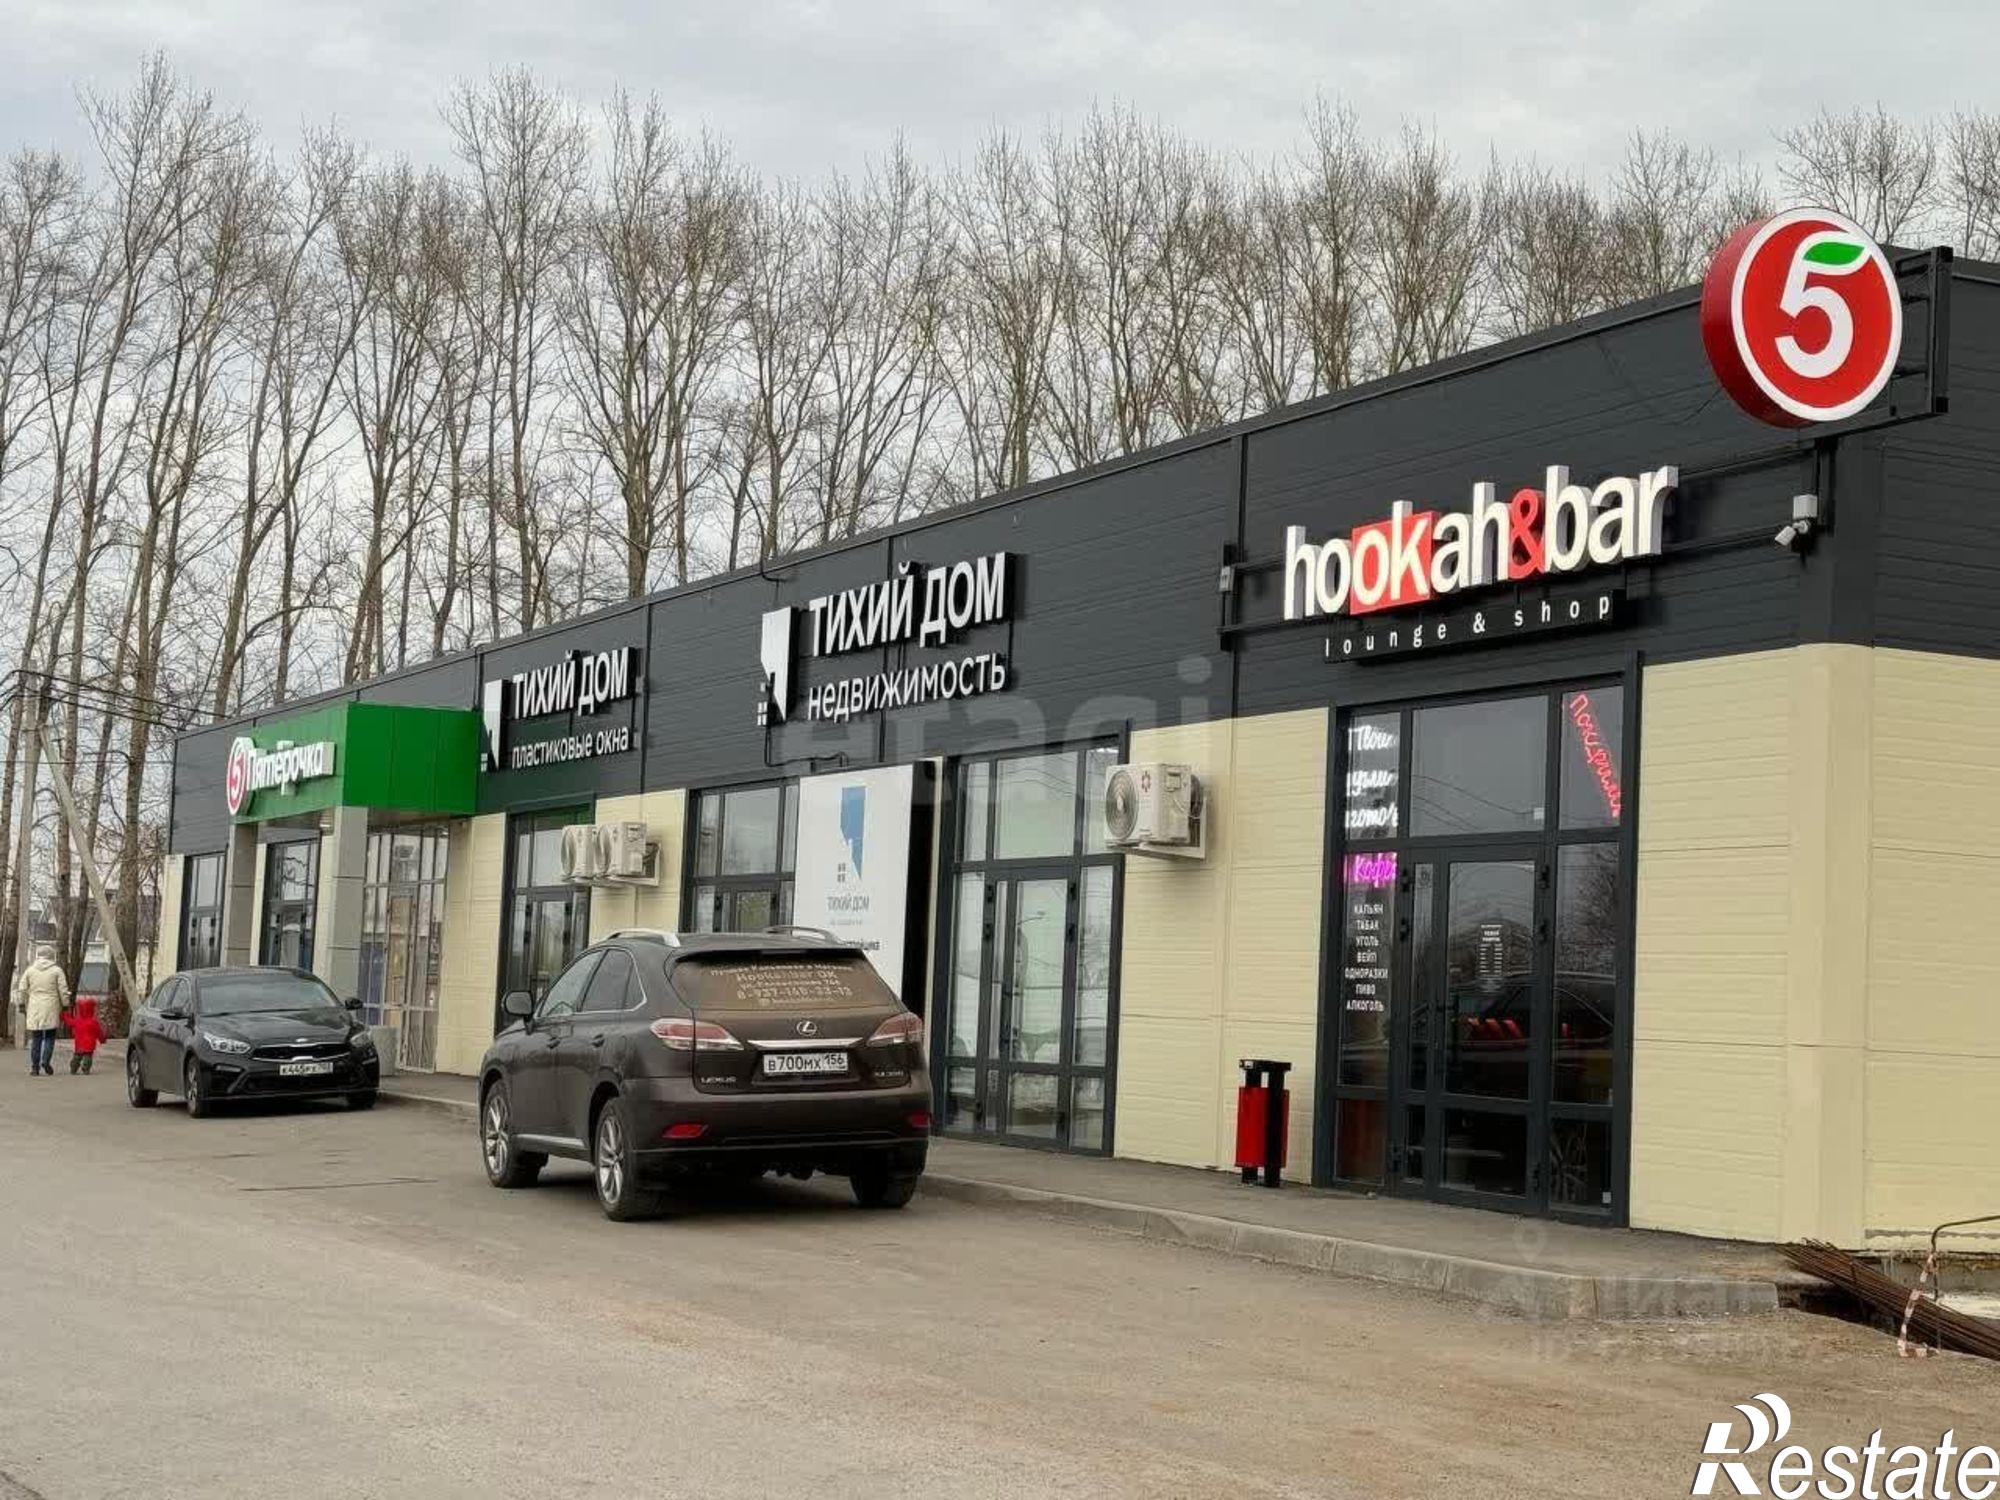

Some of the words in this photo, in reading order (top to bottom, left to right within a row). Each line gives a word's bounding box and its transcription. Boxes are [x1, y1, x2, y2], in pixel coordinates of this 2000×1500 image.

[1775, 231, 1873, 379] 5
[808, 561, 914, 657] ТИХИЙ
[919, 552, 1007, 648] ДОМ
[1325, 624, 1447, 657] lounge
[1473, 613, 1486, 634] &
[1514, 595, 1613, 628] shop
[512, 650, 576, 719] ТИХИЙ
[578, 647, 629, 717] ДОМ
[807, 653, 1005, 723] недвижимость
[511, 732, 593, 769] пластиковые
[596, 726, 629, 755] окна
[1353, 903, 1384, 916] КАЛЬЯН
[1355, 920, 1379, 931] ТАБАК
[1355, 935, 1379, 947] УГОЛЬ
[1356, 949, 1377, 963] ВЕЙП
[1345, 968, 1389, 980] ОДНОРАЗКИ
[1356, 983, 1376, 995] ПИВО
[1346, 999, 1385, 1012] АЛКОГОЛЬ
[768, 1055, 821, 1071] В700МХ
[824, 1054, 845, 1066] 156
